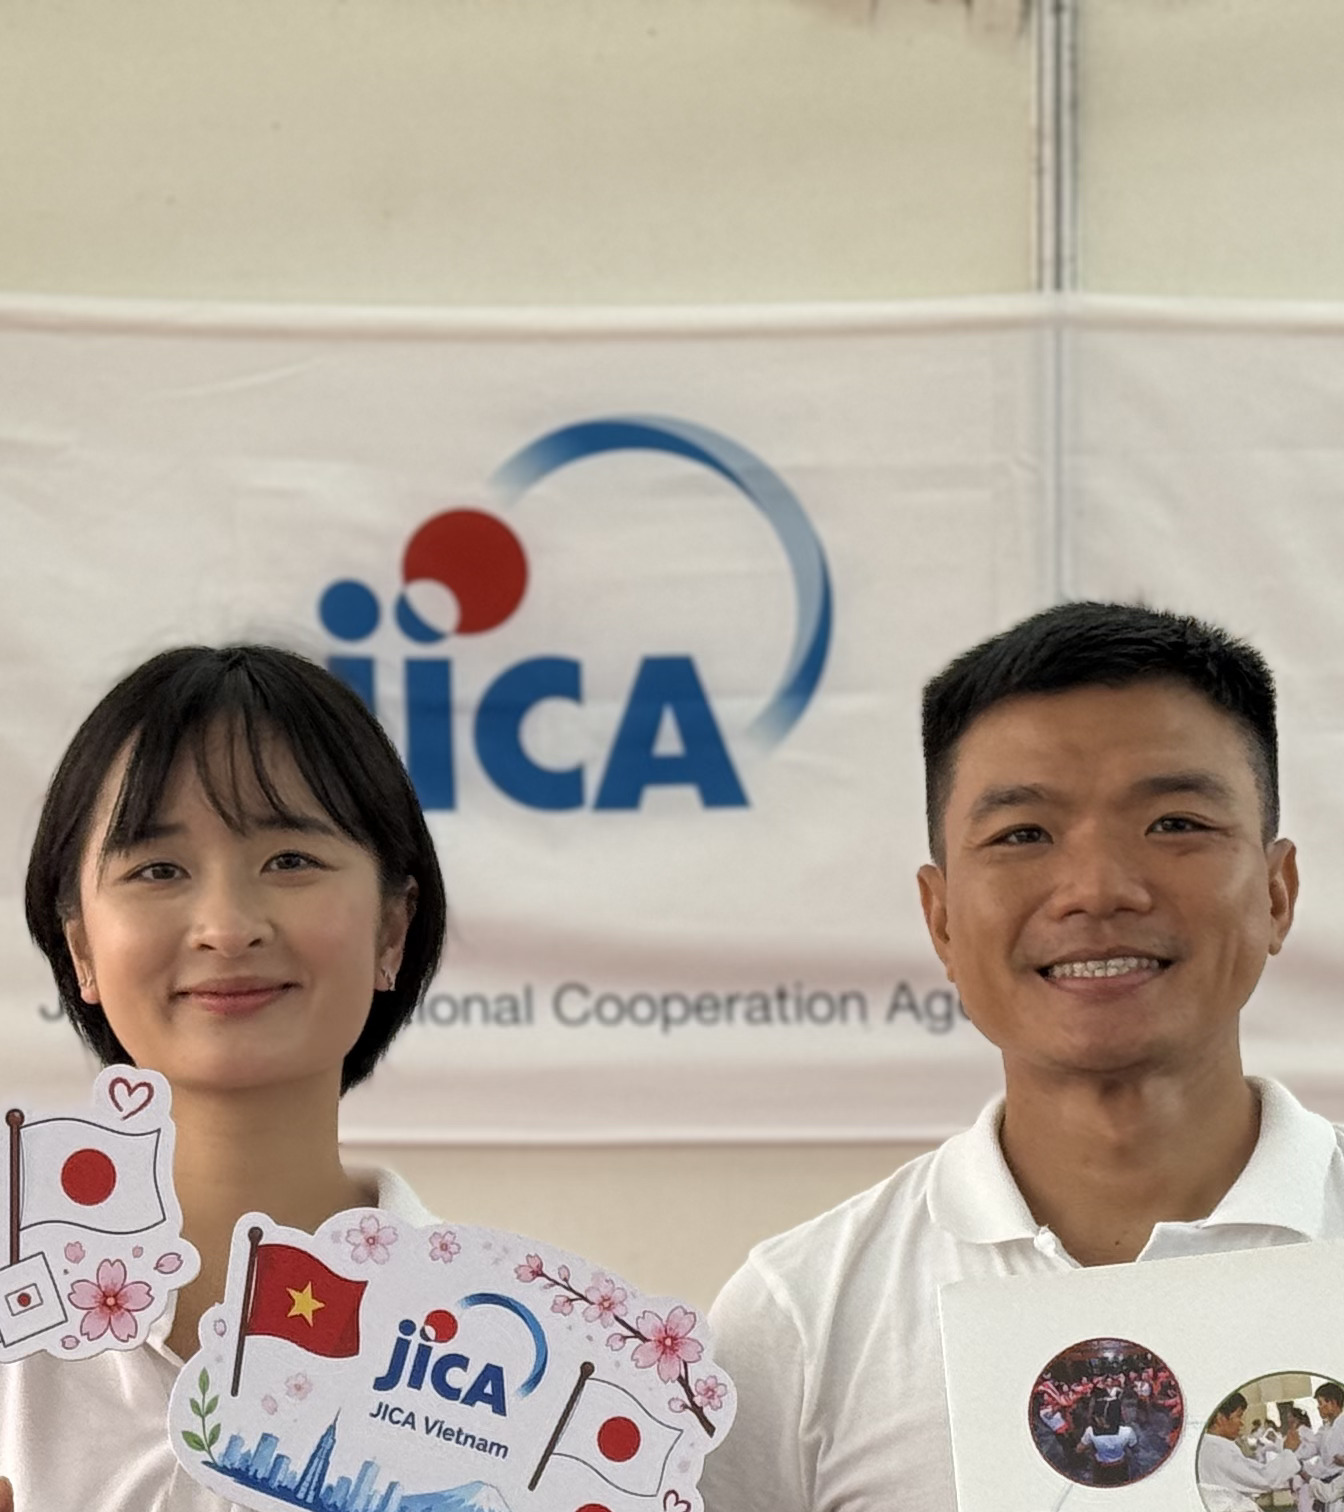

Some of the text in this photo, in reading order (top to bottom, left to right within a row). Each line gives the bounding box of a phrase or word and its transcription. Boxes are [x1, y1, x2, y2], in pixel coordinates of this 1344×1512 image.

[553, 981, 868, 1034] Cooperation
[369, 1401, 509, 1461] JICA Vietnam
